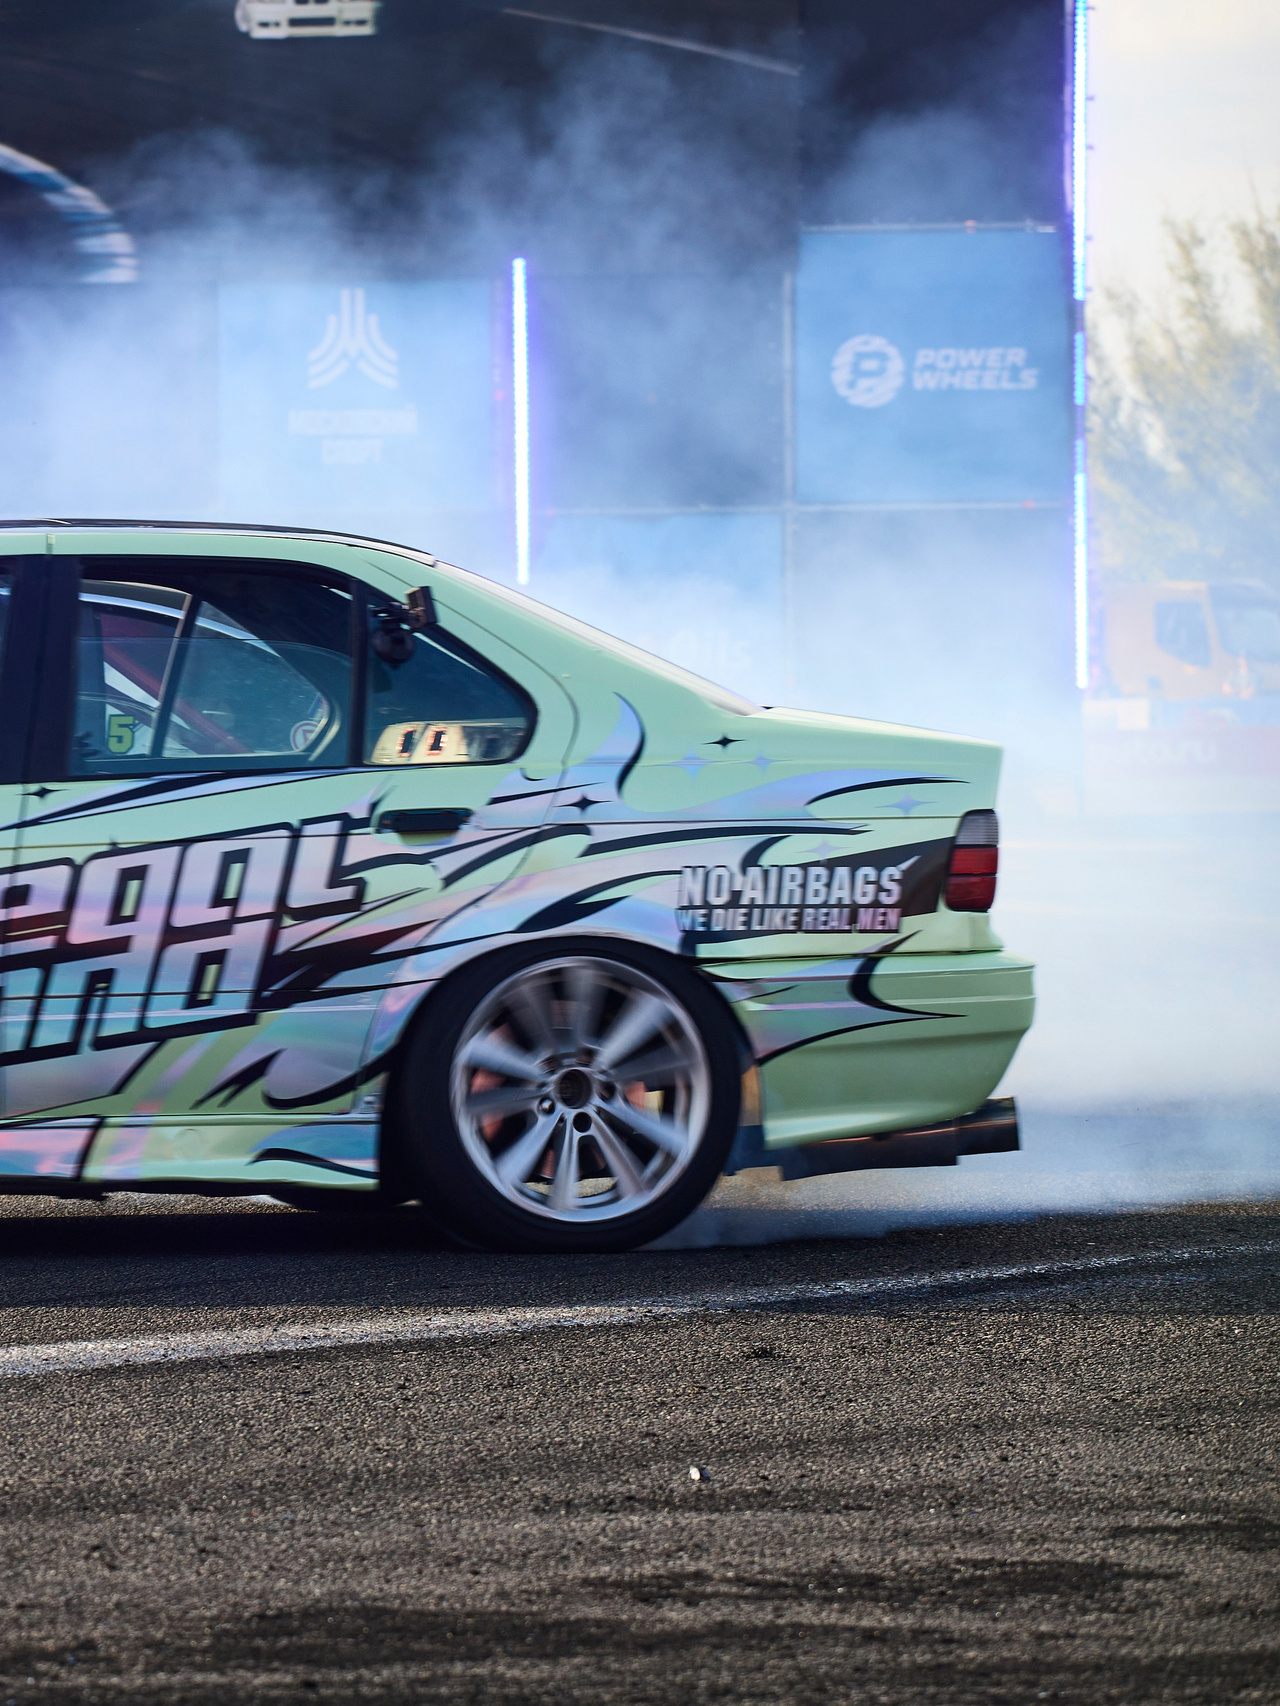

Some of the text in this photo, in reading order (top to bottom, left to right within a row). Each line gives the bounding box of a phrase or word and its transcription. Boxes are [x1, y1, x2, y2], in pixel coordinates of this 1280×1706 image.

[914, 346, 1028, 369] POWER
[912, 366, 1039, 390] WHEELS
[680, 865, 902, 906] NO AIRBAGS
[676, 908, 902, 932] WE DIE LIKE REAL MEN
